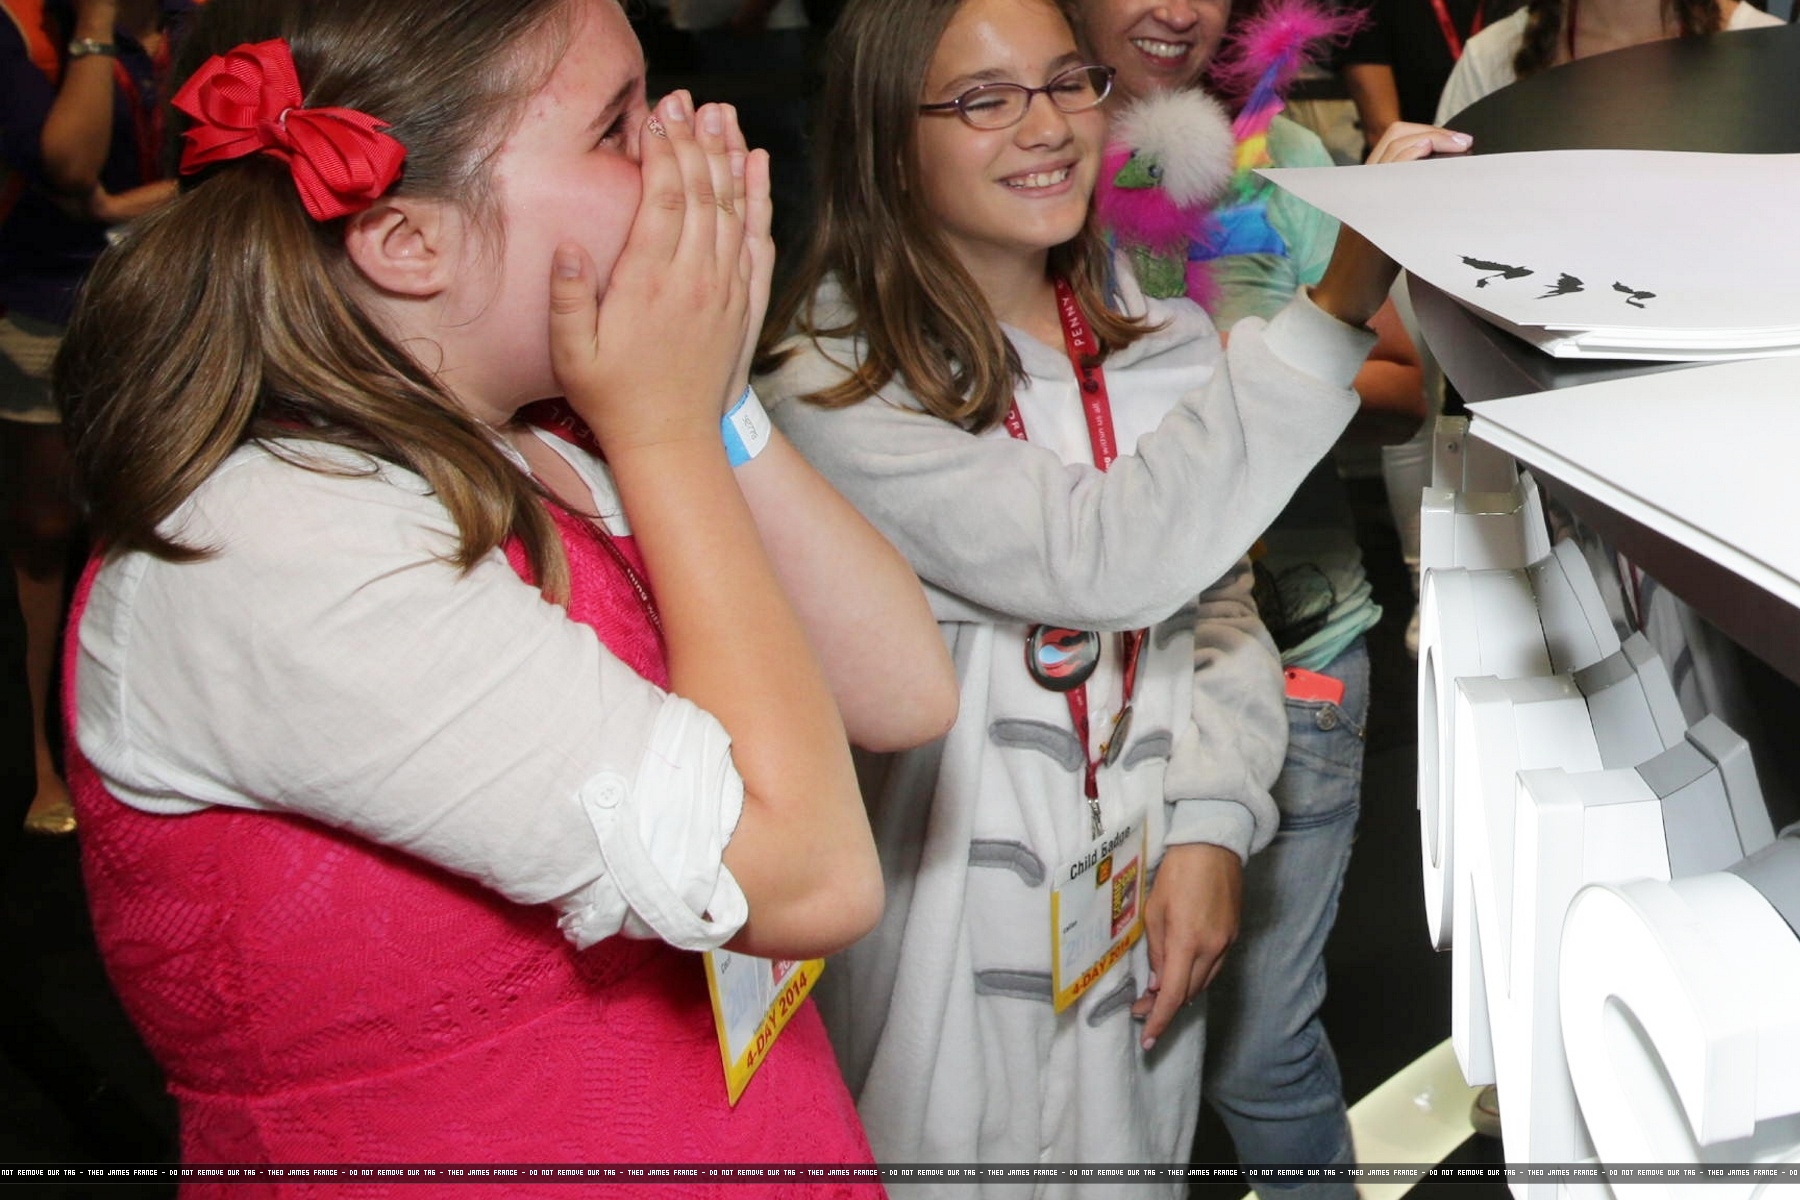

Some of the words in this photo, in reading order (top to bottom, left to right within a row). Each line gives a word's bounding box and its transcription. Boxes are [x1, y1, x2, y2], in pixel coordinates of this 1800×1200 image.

[1061, 296, 1085, 347] PENNY
[1070, 850, 1097, 881] Child
[1072, 961, 1106, 995] 4-DAY
[746, 1008, 777, 1068] 4-DAY
[779, 970, 808, 1018] 2014
